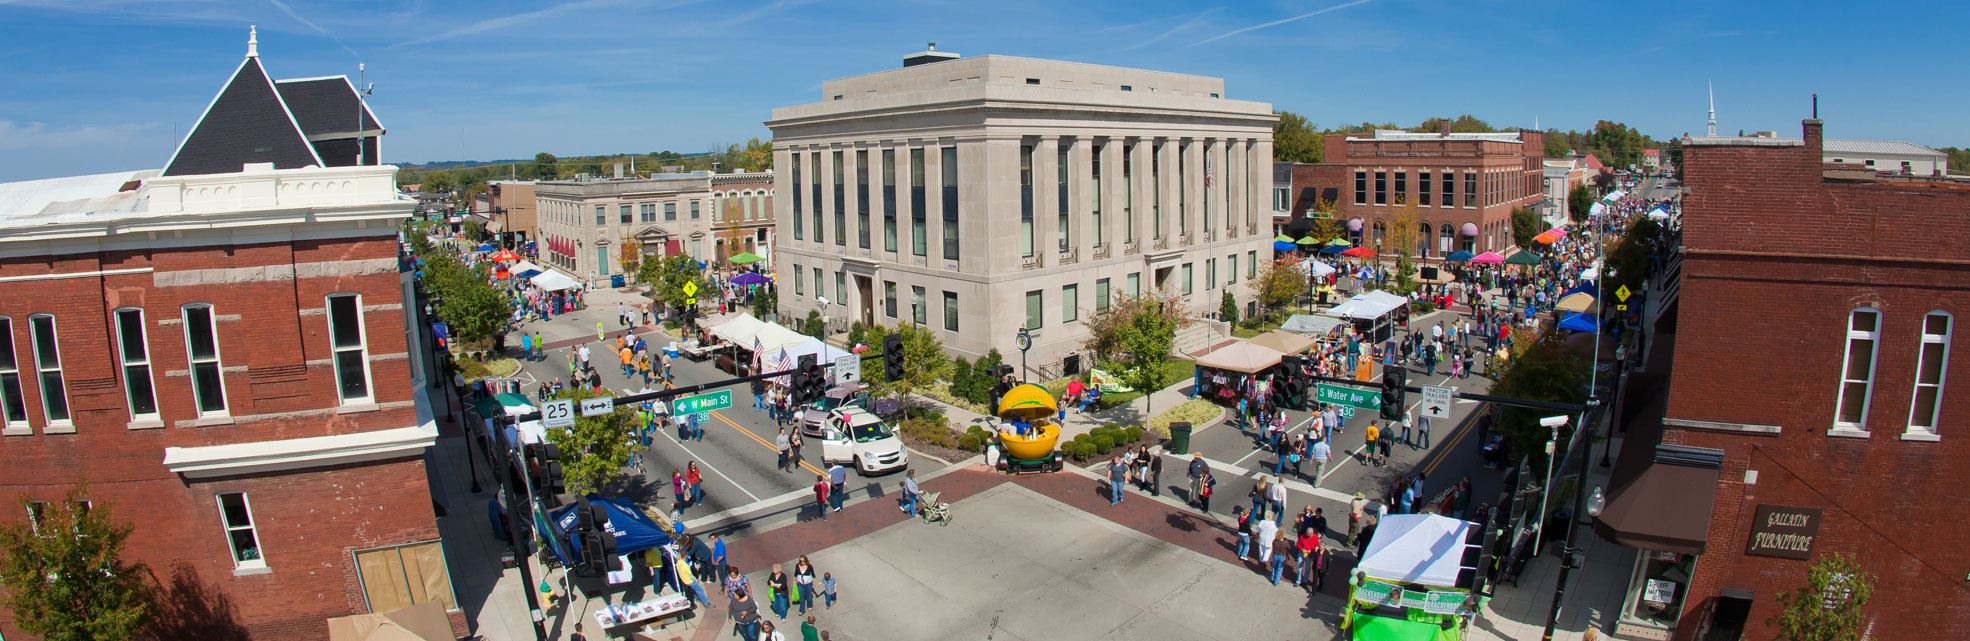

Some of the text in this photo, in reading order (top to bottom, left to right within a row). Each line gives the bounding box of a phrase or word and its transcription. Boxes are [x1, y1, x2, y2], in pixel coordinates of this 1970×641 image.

[691, 394, 728, 409] W Main St
[1320, 388, 1364, 403] S Water Ave
[547, 403, 568, 419] 25
[584, 401, 612, 412] W E
[1768, 512, 1810, 527] GALLATIN
[1751, 532, 1813, 551] FURNITURE
